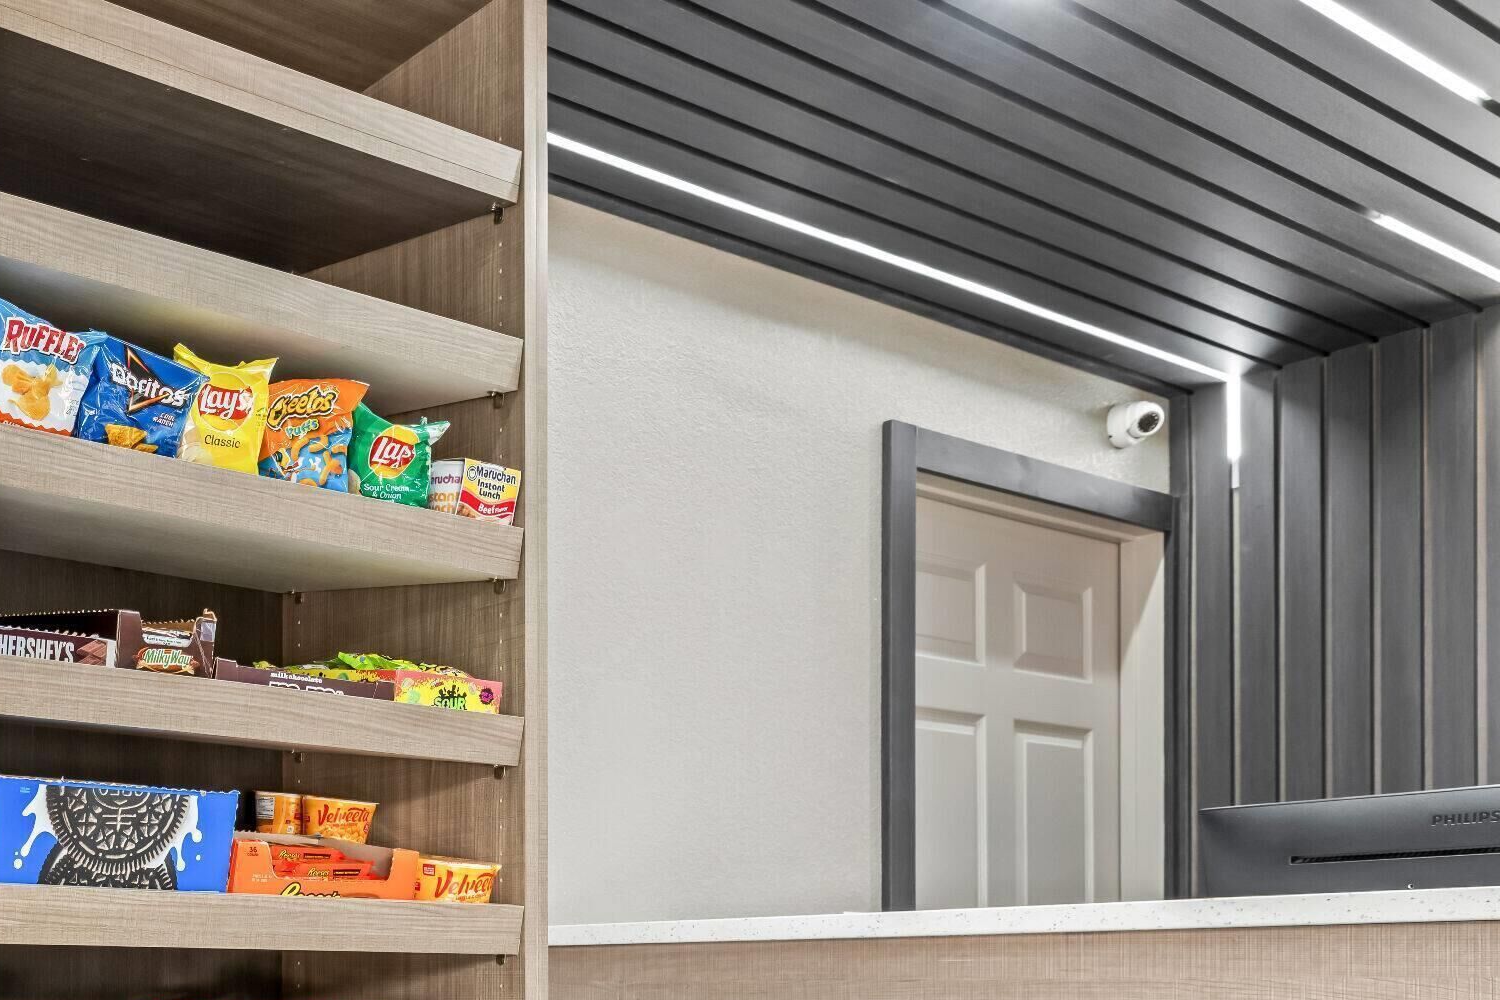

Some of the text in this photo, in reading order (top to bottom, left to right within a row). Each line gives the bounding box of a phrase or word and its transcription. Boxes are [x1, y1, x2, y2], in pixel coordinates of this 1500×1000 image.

[112, 363, 188, 408] Doritos
[267, 386, 336, 429] Cheetos
[204, 434, 241, 449] Classic
[477, 466, 516, 485] Maruchan
[363, 484, 409, 493] Sour Cream
[478, 478, 505, 492] Instant
[380, 491, 401, 499] Onion
[479, 488, 500, 501] Lunch
[478, 503, 495, 515] Beef
[433, 697, 466, 710] SOUR
[318, 804, 370, 826] Velveeta
[1431, 810, 1500, 827] PHILIPS
